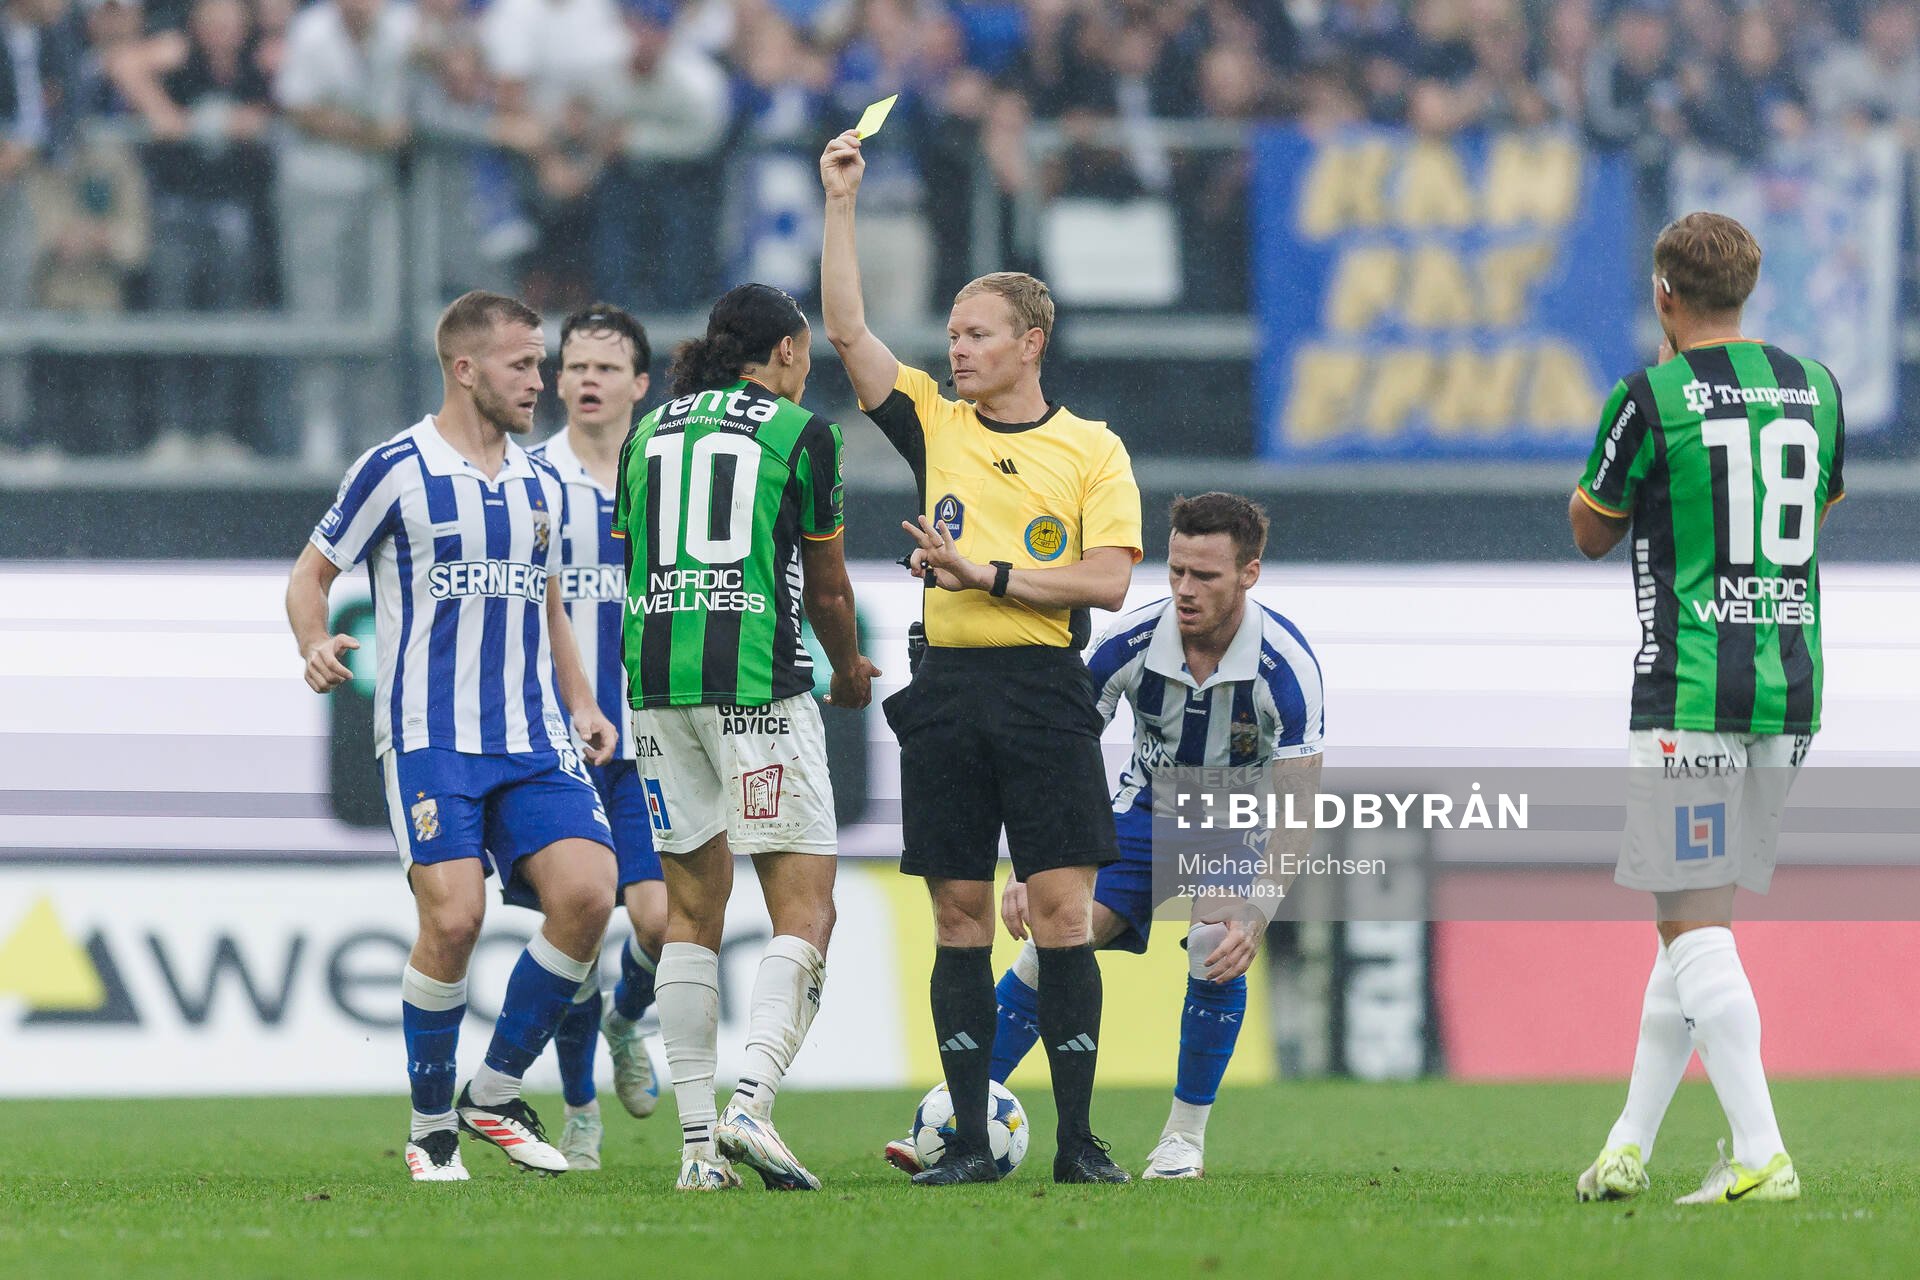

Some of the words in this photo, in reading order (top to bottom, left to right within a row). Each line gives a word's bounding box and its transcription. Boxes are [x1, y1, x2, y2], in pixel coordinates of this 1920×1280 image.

[653, 390, 779, 422] renta
[1714, 385, 1820, 407] Tranpenad
[657, 415, 754, 433] MASKINUTHYRNING
[1611, 400, 1636, 440] Group
[645, 432, 762, 566] 10
[1701, 418, 1820, 566] 18
[429, 560, 547, 602] SERNEKE
[561, 567, 625, 601] ERN
[651, 570, 741, 592] NORDIC
[1720, 577, 1807, 601] NORDIC
[628, 592, 765, 615] WELLNESS
[723, 717, 790, 735] ADVICE
[1300, 745, 1316, 755] IFK
[1663, 754, 1738, 779] RASTA
